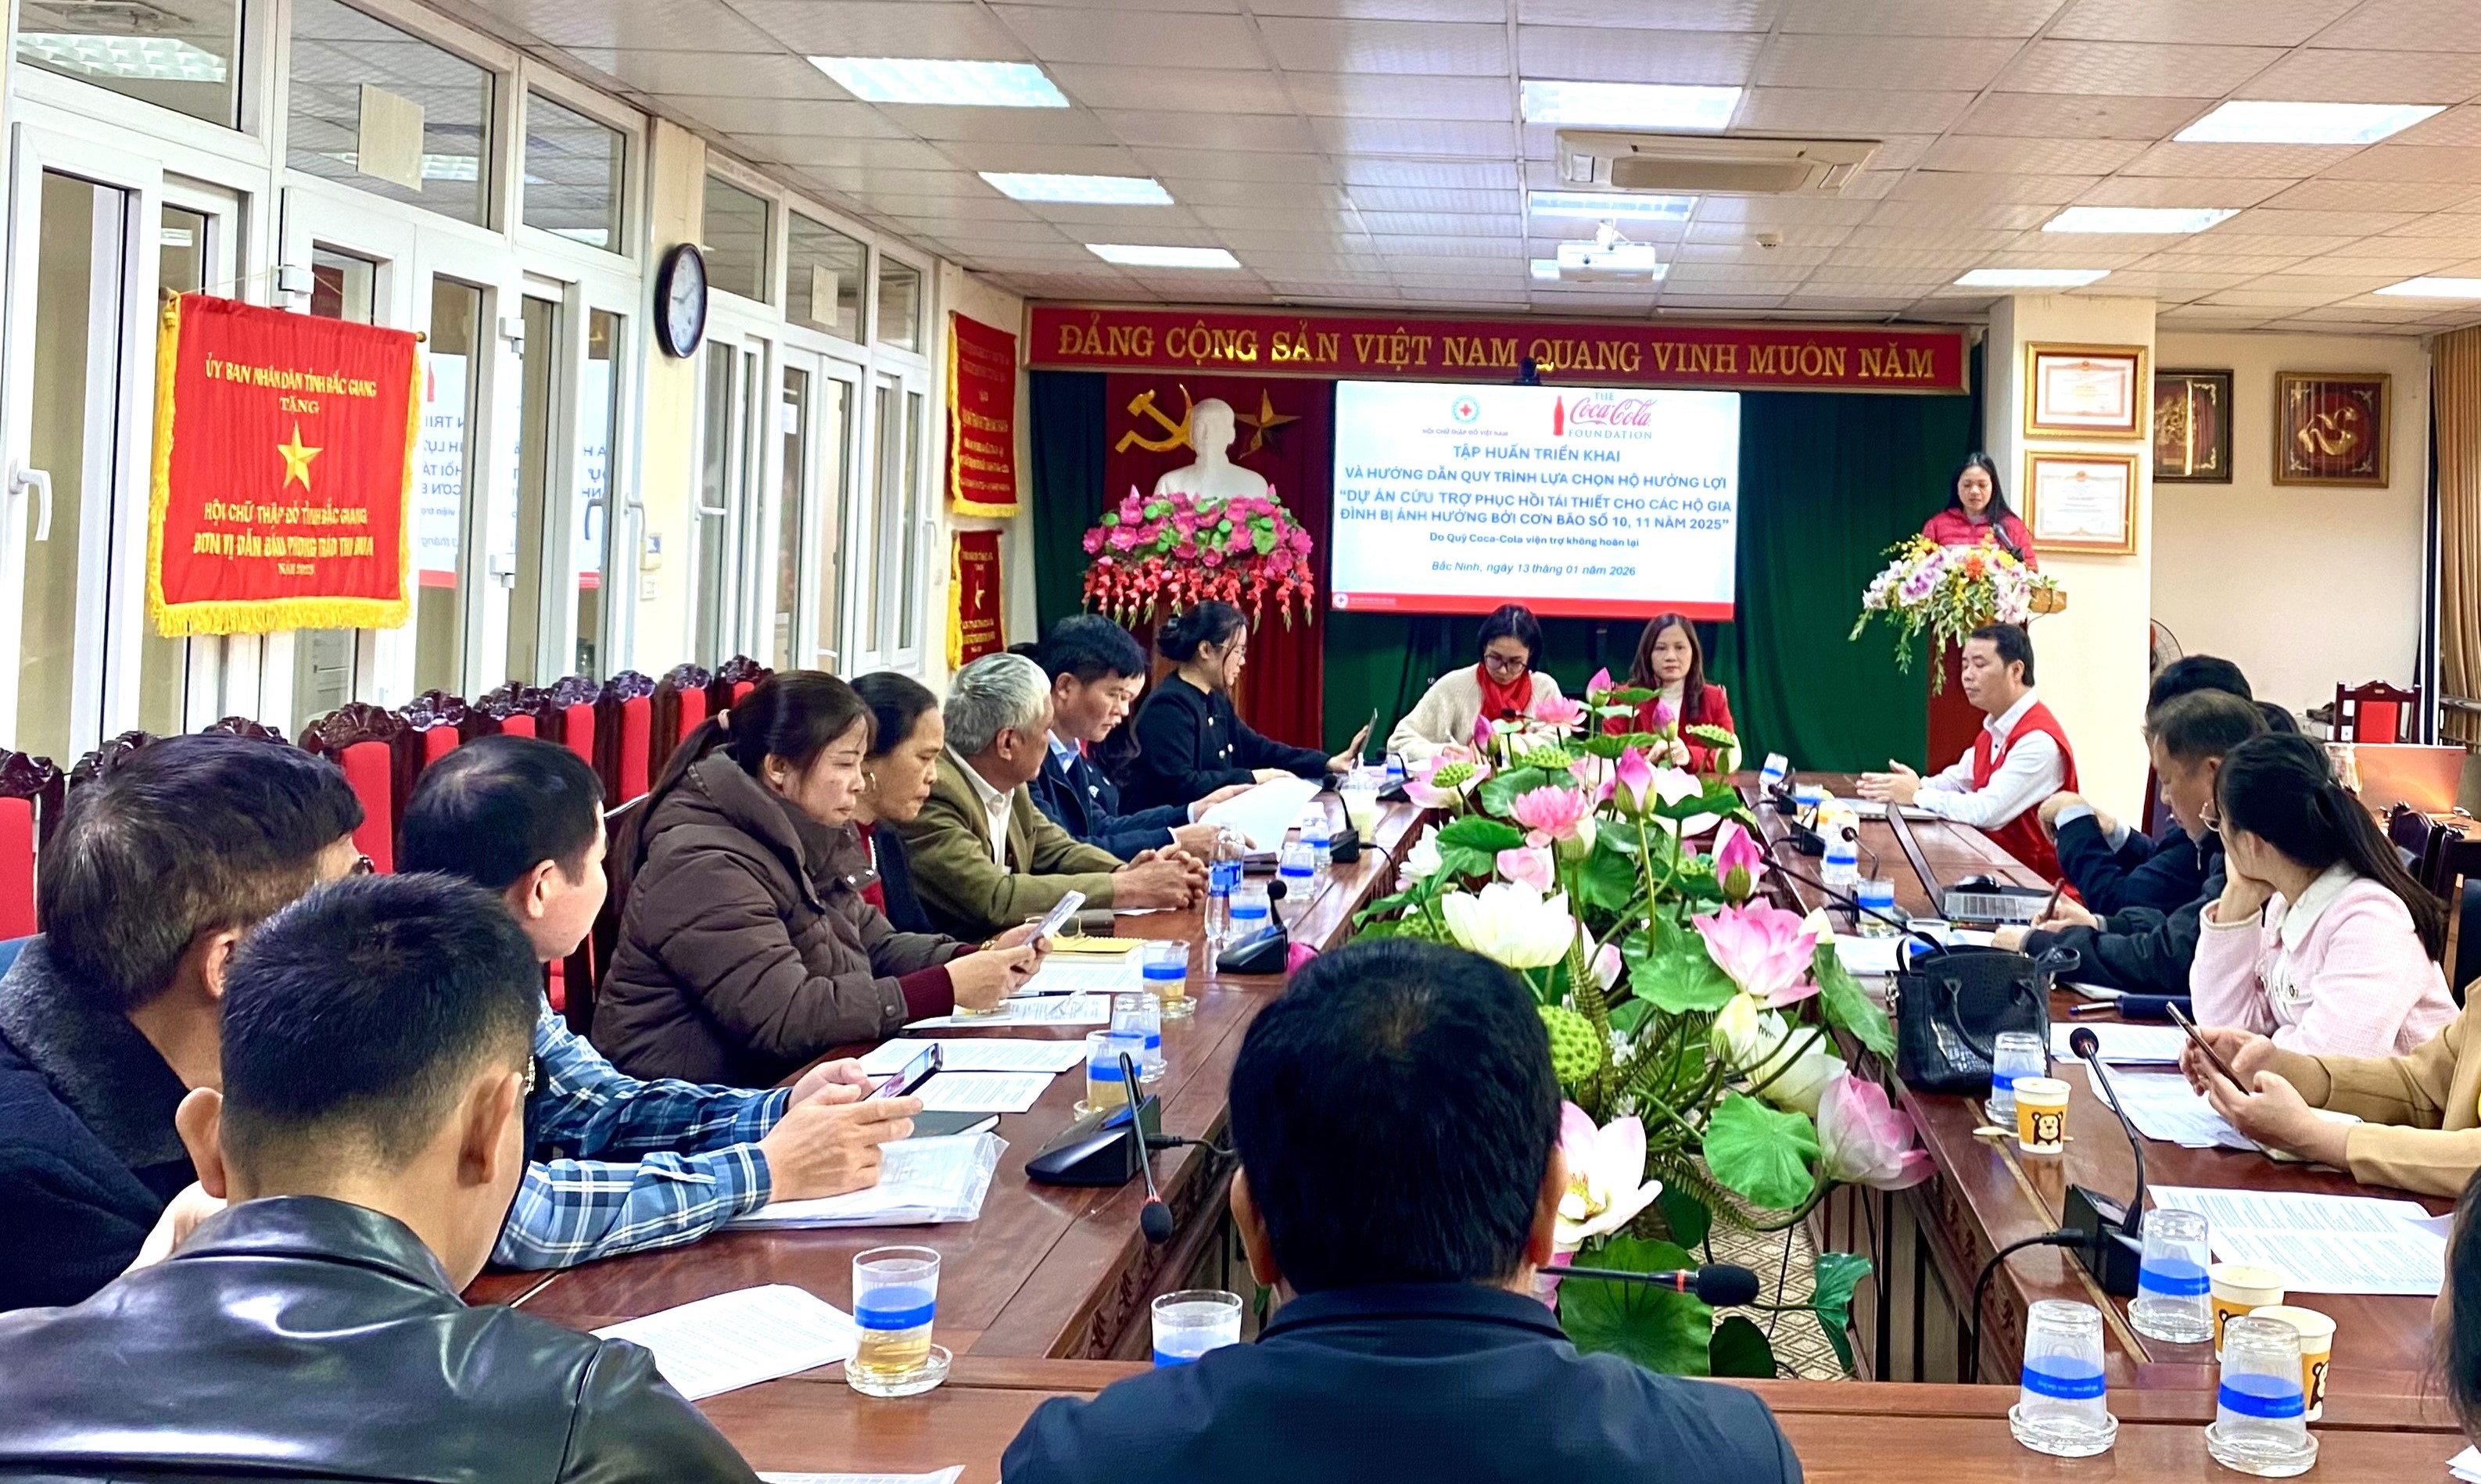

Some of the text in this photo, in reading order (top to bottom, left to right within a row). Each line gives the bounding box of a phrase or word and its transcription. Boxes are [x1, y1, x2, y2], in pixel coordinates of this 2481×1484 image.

[1058, 314, 1935, 378] ĐẢNG CỘNG SẢN VIỆT NAM QUANG VINH MUÔN NĂM
[206, 352, 223, 378] ỦY
[226, 361, 251, 384] BAN
[253, 364, 281, 389] NHÂN
[281, 367, 303, 390] DÂN
[326, 369, 346, 395] BẮC
[348, 378, 377, 397] GIANG
[279, 396, 320, 414] TẶNG
[1569, 429, 1652, 439] FOUNDATION
[1454, 443, 1620, 462] TẬP HUẤN TRIỂN KHAI
[1345, 465, 1726, 491] VÀ HƯỚNG DẪN QUY TRÌNH LỰA CHỌN HỘ HƯỞNG LỢI
[1375, 488, 1395, 503] ÁN
[1400, 489, 1434, 504] CỨU
[1439, 492, 1472, 507] TRỢ
[1475, 494, 1515, 507] PHỤC
[1518, 491, 1543, 507] HỒI
[1547, 494, 1567, 507] TÁI
[1571, 493, 1611, 509] THIẾT
[1614, 498, 1645, 510] CHO
[1649, 496, 1679, 510] CÁC
[1683, 498, 1703, 512] HỘ
[1708, 500, 1731, 512] GIA
[204, 498, 226, 526] HỘI
[228, 500, 255, 523] CHỮ
[256, 501, 285, 530] THẬP
[1340, 507, 1376, 521] ĐÌNH
[1381, 509, 1393, 523] BỊ
[1397, 507, 1427, 522] ẢNH
[1431, 508, 1487, 523] HƯỞNG
[1491, 509, 1516, 524] BỞI
[1520, 513, 1552, 525] CƠN
[1557, 512, 1585, 526] BÃO
[1589, 512, 1608, 527] SỐ
[1612, 516, 1631, 529] 10,
[1636, 517, 1650, 528] 11
[1655, 515, 1686, 529] NĂM
[1429, 532, 1639, 548] Do Quỹ Coca-Cola viện trợ không hoàn lại
[1432, 561, 1636, 576] Bắc Ninh, ngày 13 tháng 01 năm 2026
